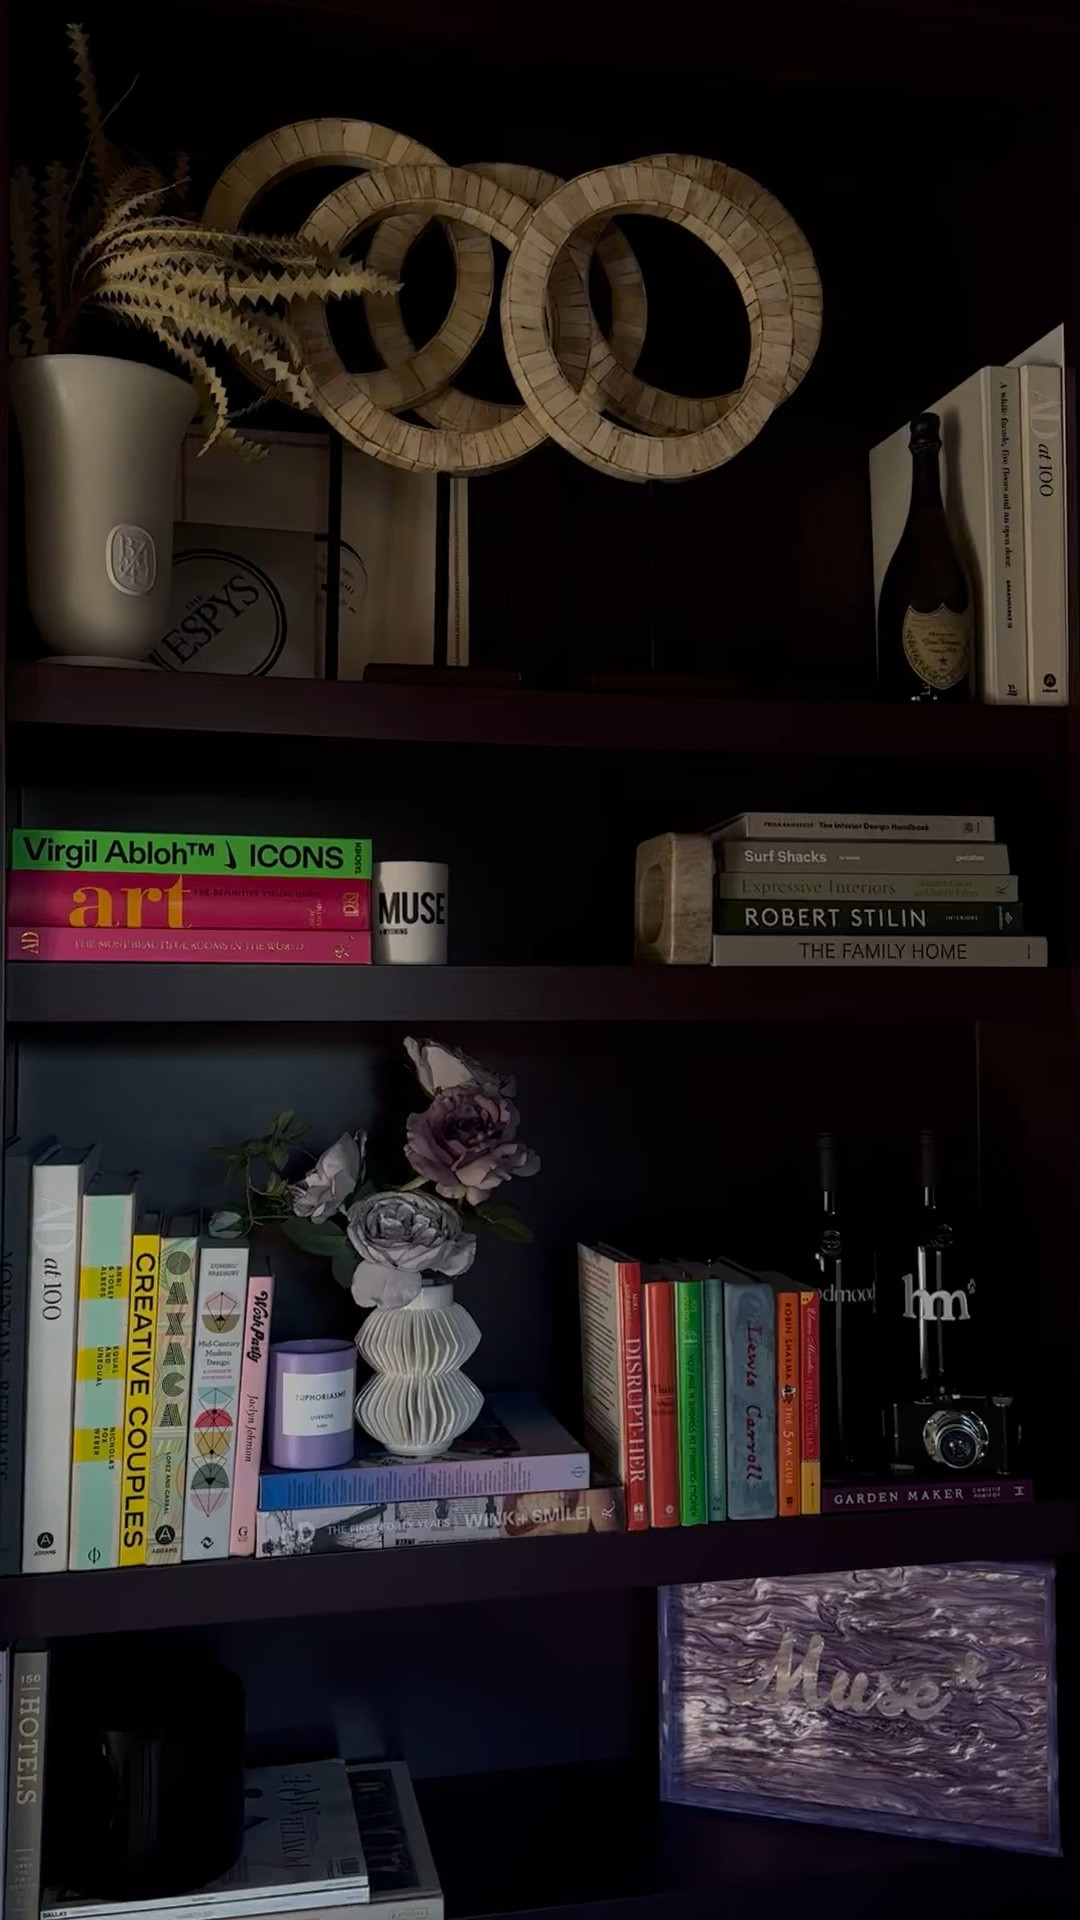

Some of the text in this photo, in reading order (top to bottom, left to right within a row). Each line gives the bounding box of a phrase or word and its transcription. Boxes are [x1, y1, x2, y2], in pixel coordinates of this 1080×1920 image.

[1032, 390, 1060, 497] AD at 100
[161, 575, 260, 665] ESPYS
[819, 821, 930, 832] The Interior Design Handbook
[24, 836, 98, 869] Virgil
[250, 843, 344, 870] ICONS
[744, 850, 775, 864] Surf
[777, 849, 828, 864] Shacks
[68, 874, 192, 930] art
[194, 887, 210, 897] THE
[213, 888, 259, 898] DEFINITIVE
[741, 880, 823, 897] Expressive
[829, 879, 896, 896] Interiors
[378, 892, 446, 925] MUSE
[744, 907, 928, 929] ROBERT STILIN
[19, 929, 40, 956] AD
[190, 941, 228, 951] ROOMS
[798, 942, 968, 960] THE FAMILY HOME
[35, 1196, 76, 1321] AD at 100
[253, 1290, 268, 1328] Work
[199, 1340, 240, 1350] Mid-Century
[746, 1322, 763, 1387] Lewis
[784, 1302, 793, 1381] ROBIN SHARMA
[96, 1346, 105, 1388] UNEQUAL
[206, 1358, 230, 1367] Design
[124, 1252, 156, 1548] CREATIVE COUPLES
[625, 1338, 648, 1483] DISRUPT-HER
[101, 1427, 109, 1444] FOX
[244, 1394, 258, 1463] Jaclyn Johnson
[745, 1404, 763, 1481] Carroll
[782, 1406, 795, 1485] THE 5 AM CLUB
[107, 1426, 117, 1470] NICHOLAS
[834, 1487, 964, 1506] GARDEN MAKER
[326, 1524, 347, 1536] THE
[464, 1510, 516, 1529] WINK
[531, 1504, 591, 1524] SMILE!
[20, 1674, 41, 1684] 150
[726, 1629, 954, 1721] Muse
[16, 1696, 40, 1806] HOTELS
